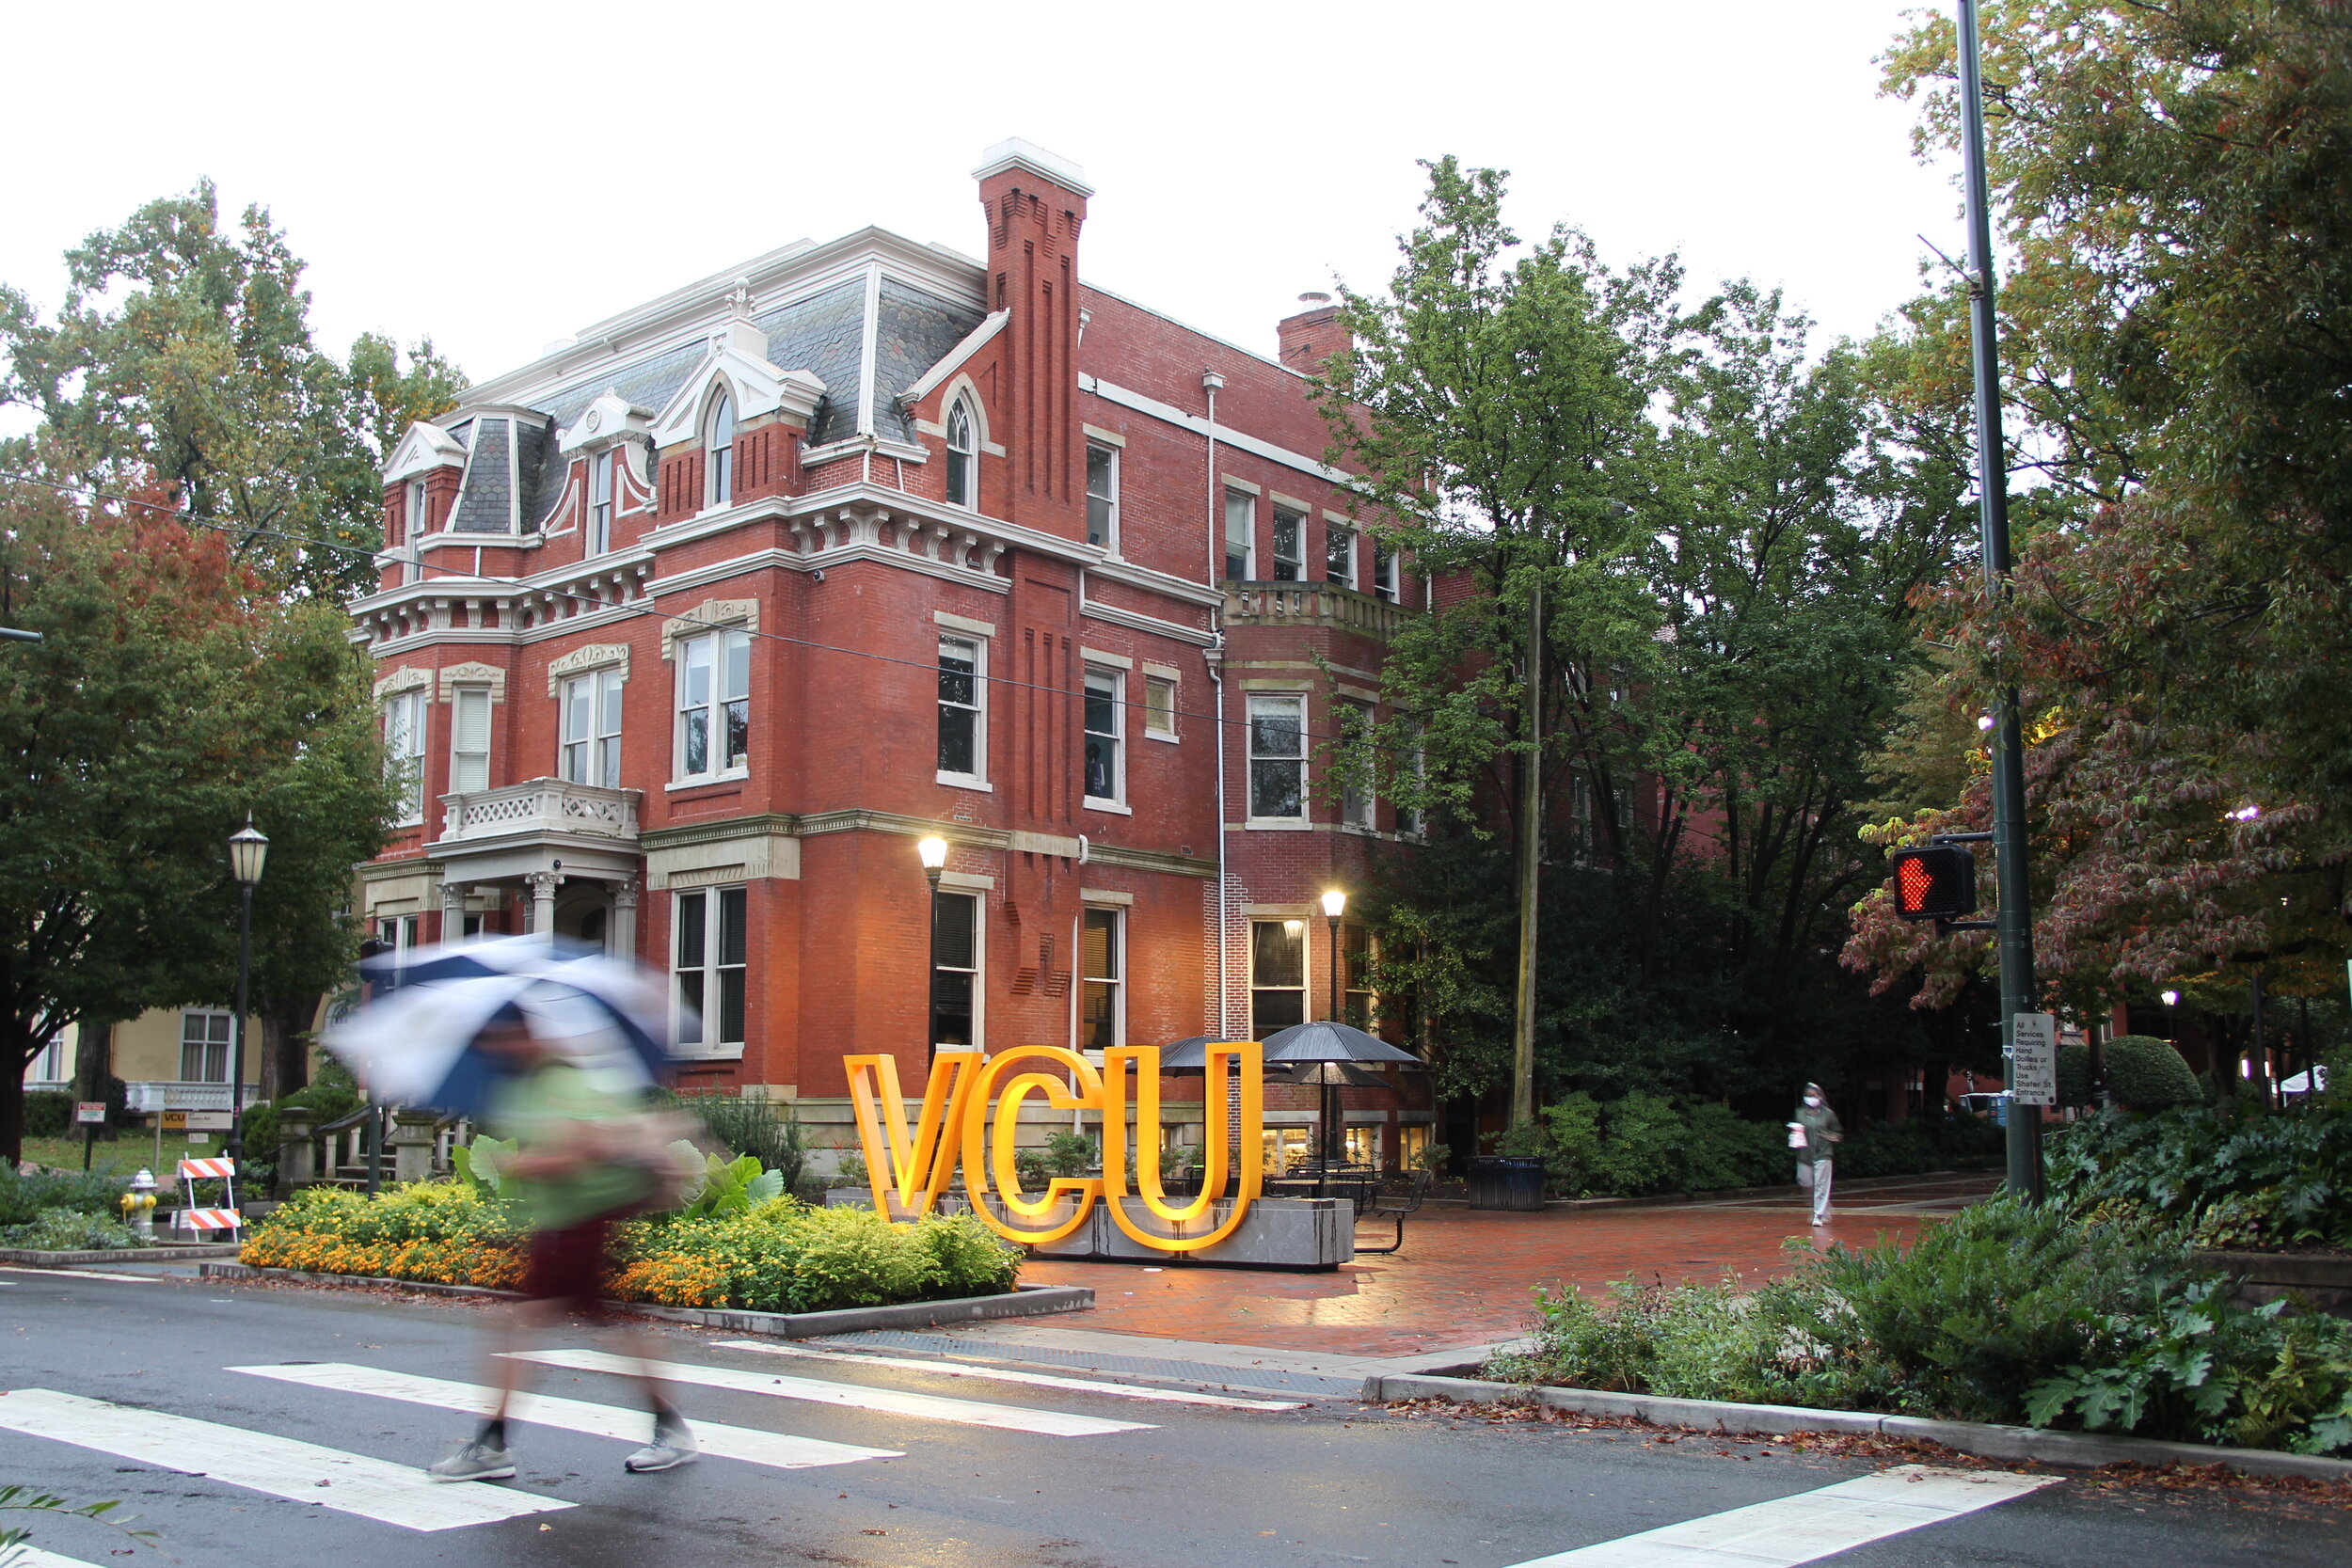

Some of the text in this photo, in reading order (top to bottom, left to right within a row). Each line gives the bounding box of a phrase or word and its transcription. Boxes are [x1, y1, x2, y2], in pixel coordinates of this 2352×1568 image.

[2016, 1038, 2045, 1047] Requiring
[165, 1113, 185, 1122] VCU
[843, 1041, 1263, 1251] VCU
